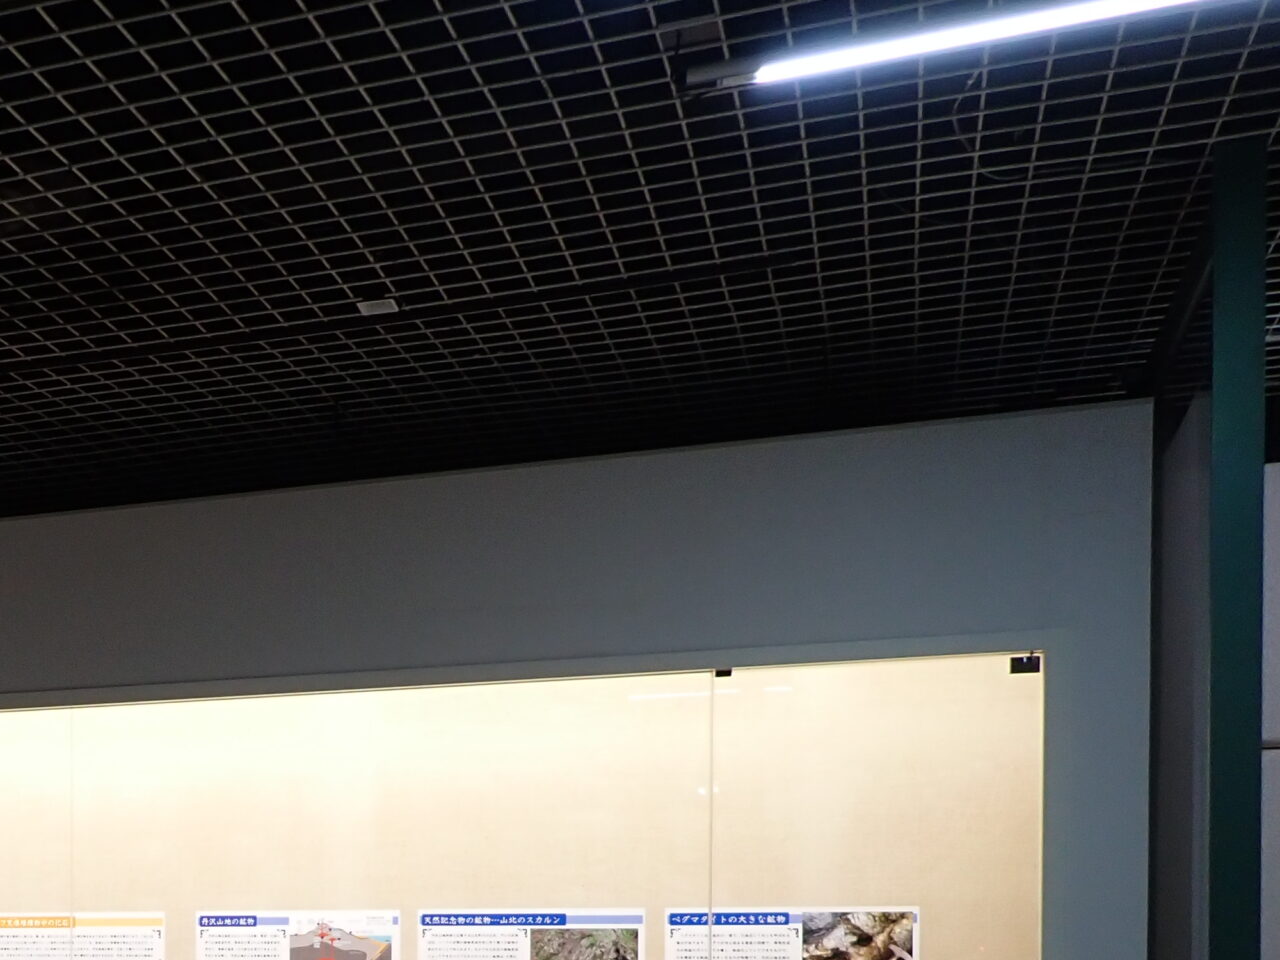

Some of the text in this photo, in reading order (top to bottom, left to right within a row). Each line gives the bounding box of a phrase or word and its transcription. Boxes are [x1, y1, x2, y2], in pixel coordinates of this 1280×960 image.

[201, 917, 255, 926] 丹沢山地の鉱物
[671, 914, 786, 924] ペグマタイトの大きな鉱物
